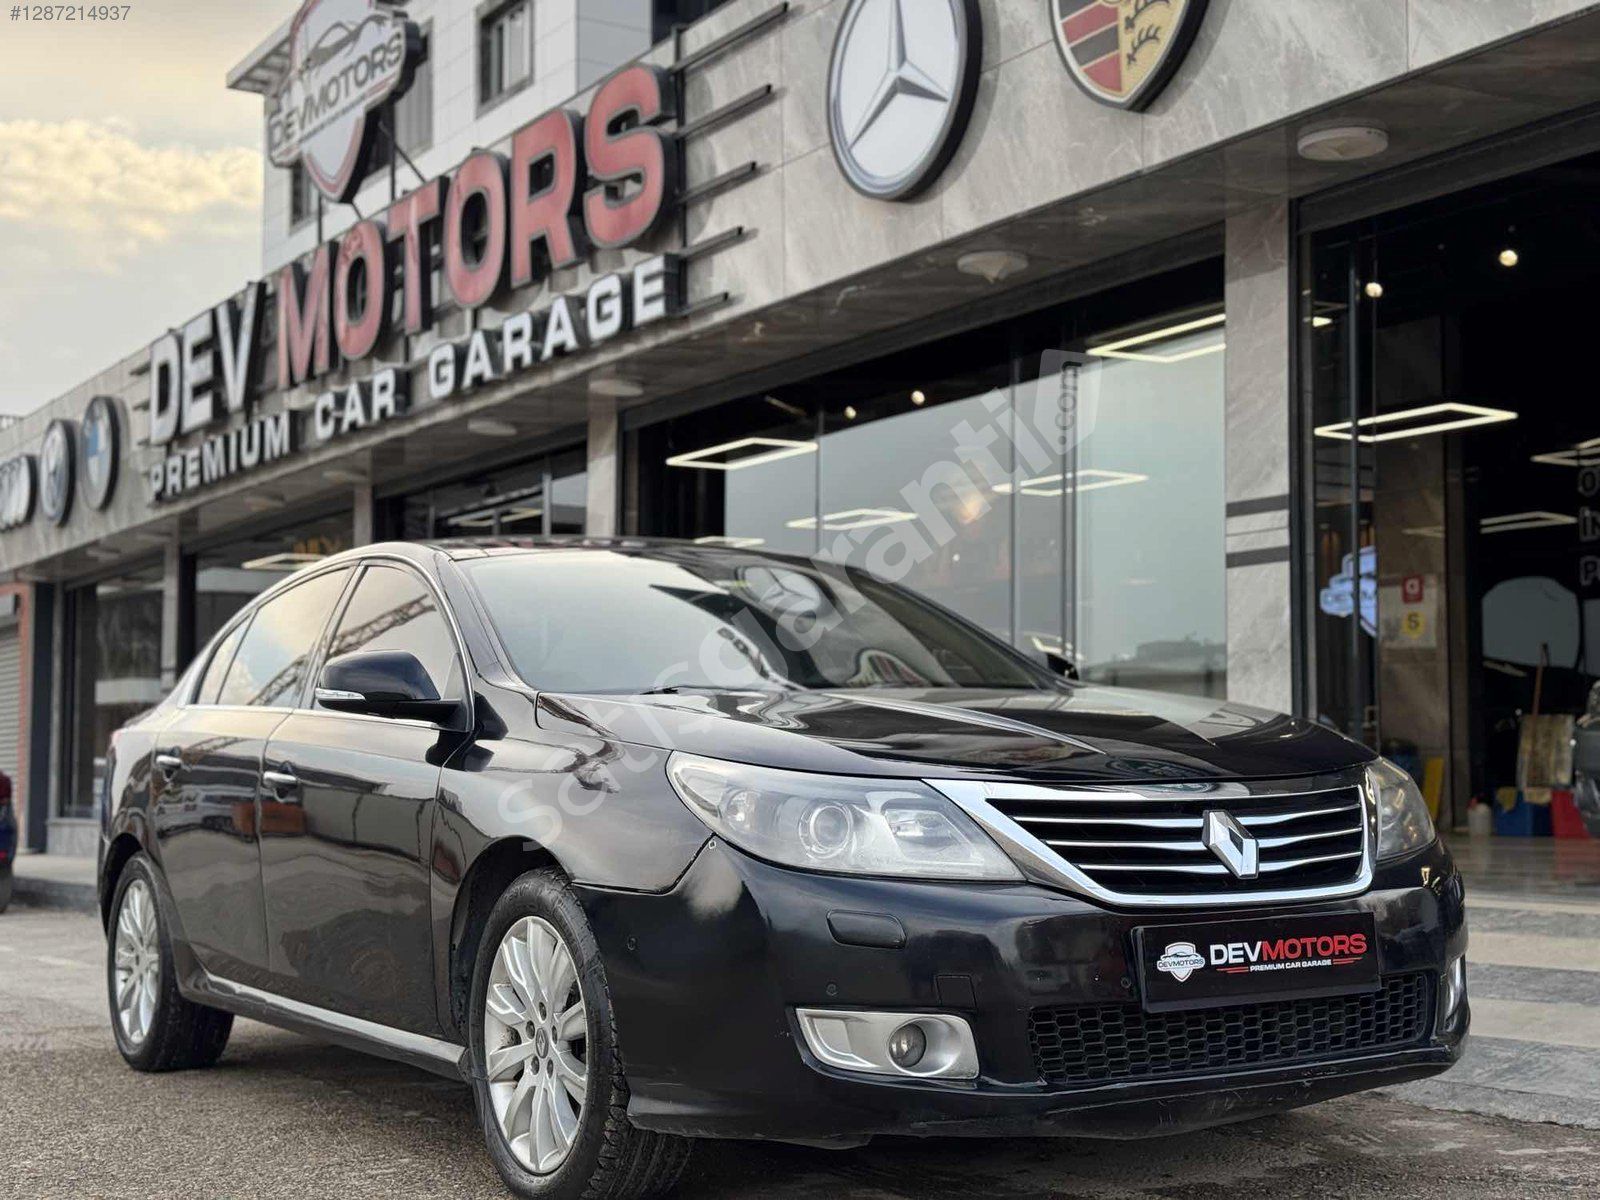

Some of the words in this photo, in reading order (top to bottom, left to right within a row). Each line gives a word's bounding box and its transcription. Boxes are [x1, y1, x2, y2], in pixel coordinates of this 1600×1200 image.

[269, 32, 402, 151] DEVMOTORS
[149, 281, 258, 446] DEV
[277, 62, 665, 392] MOTORS
[150, 410, 291, 500] PREMIUM
[314, 368, 397, 441] CAR
[428, 254, 666, 400] GARAGE
[1158, 958, 1205, 969] DEVMOTORS
[1209, 933, 1367, 965] DEVMOTORS
[1249, 963, 1285, 972] PREMIUM
[1285, 961, 1302, 969] CAR
[1302, 959, 1332, 968] GARAGE
